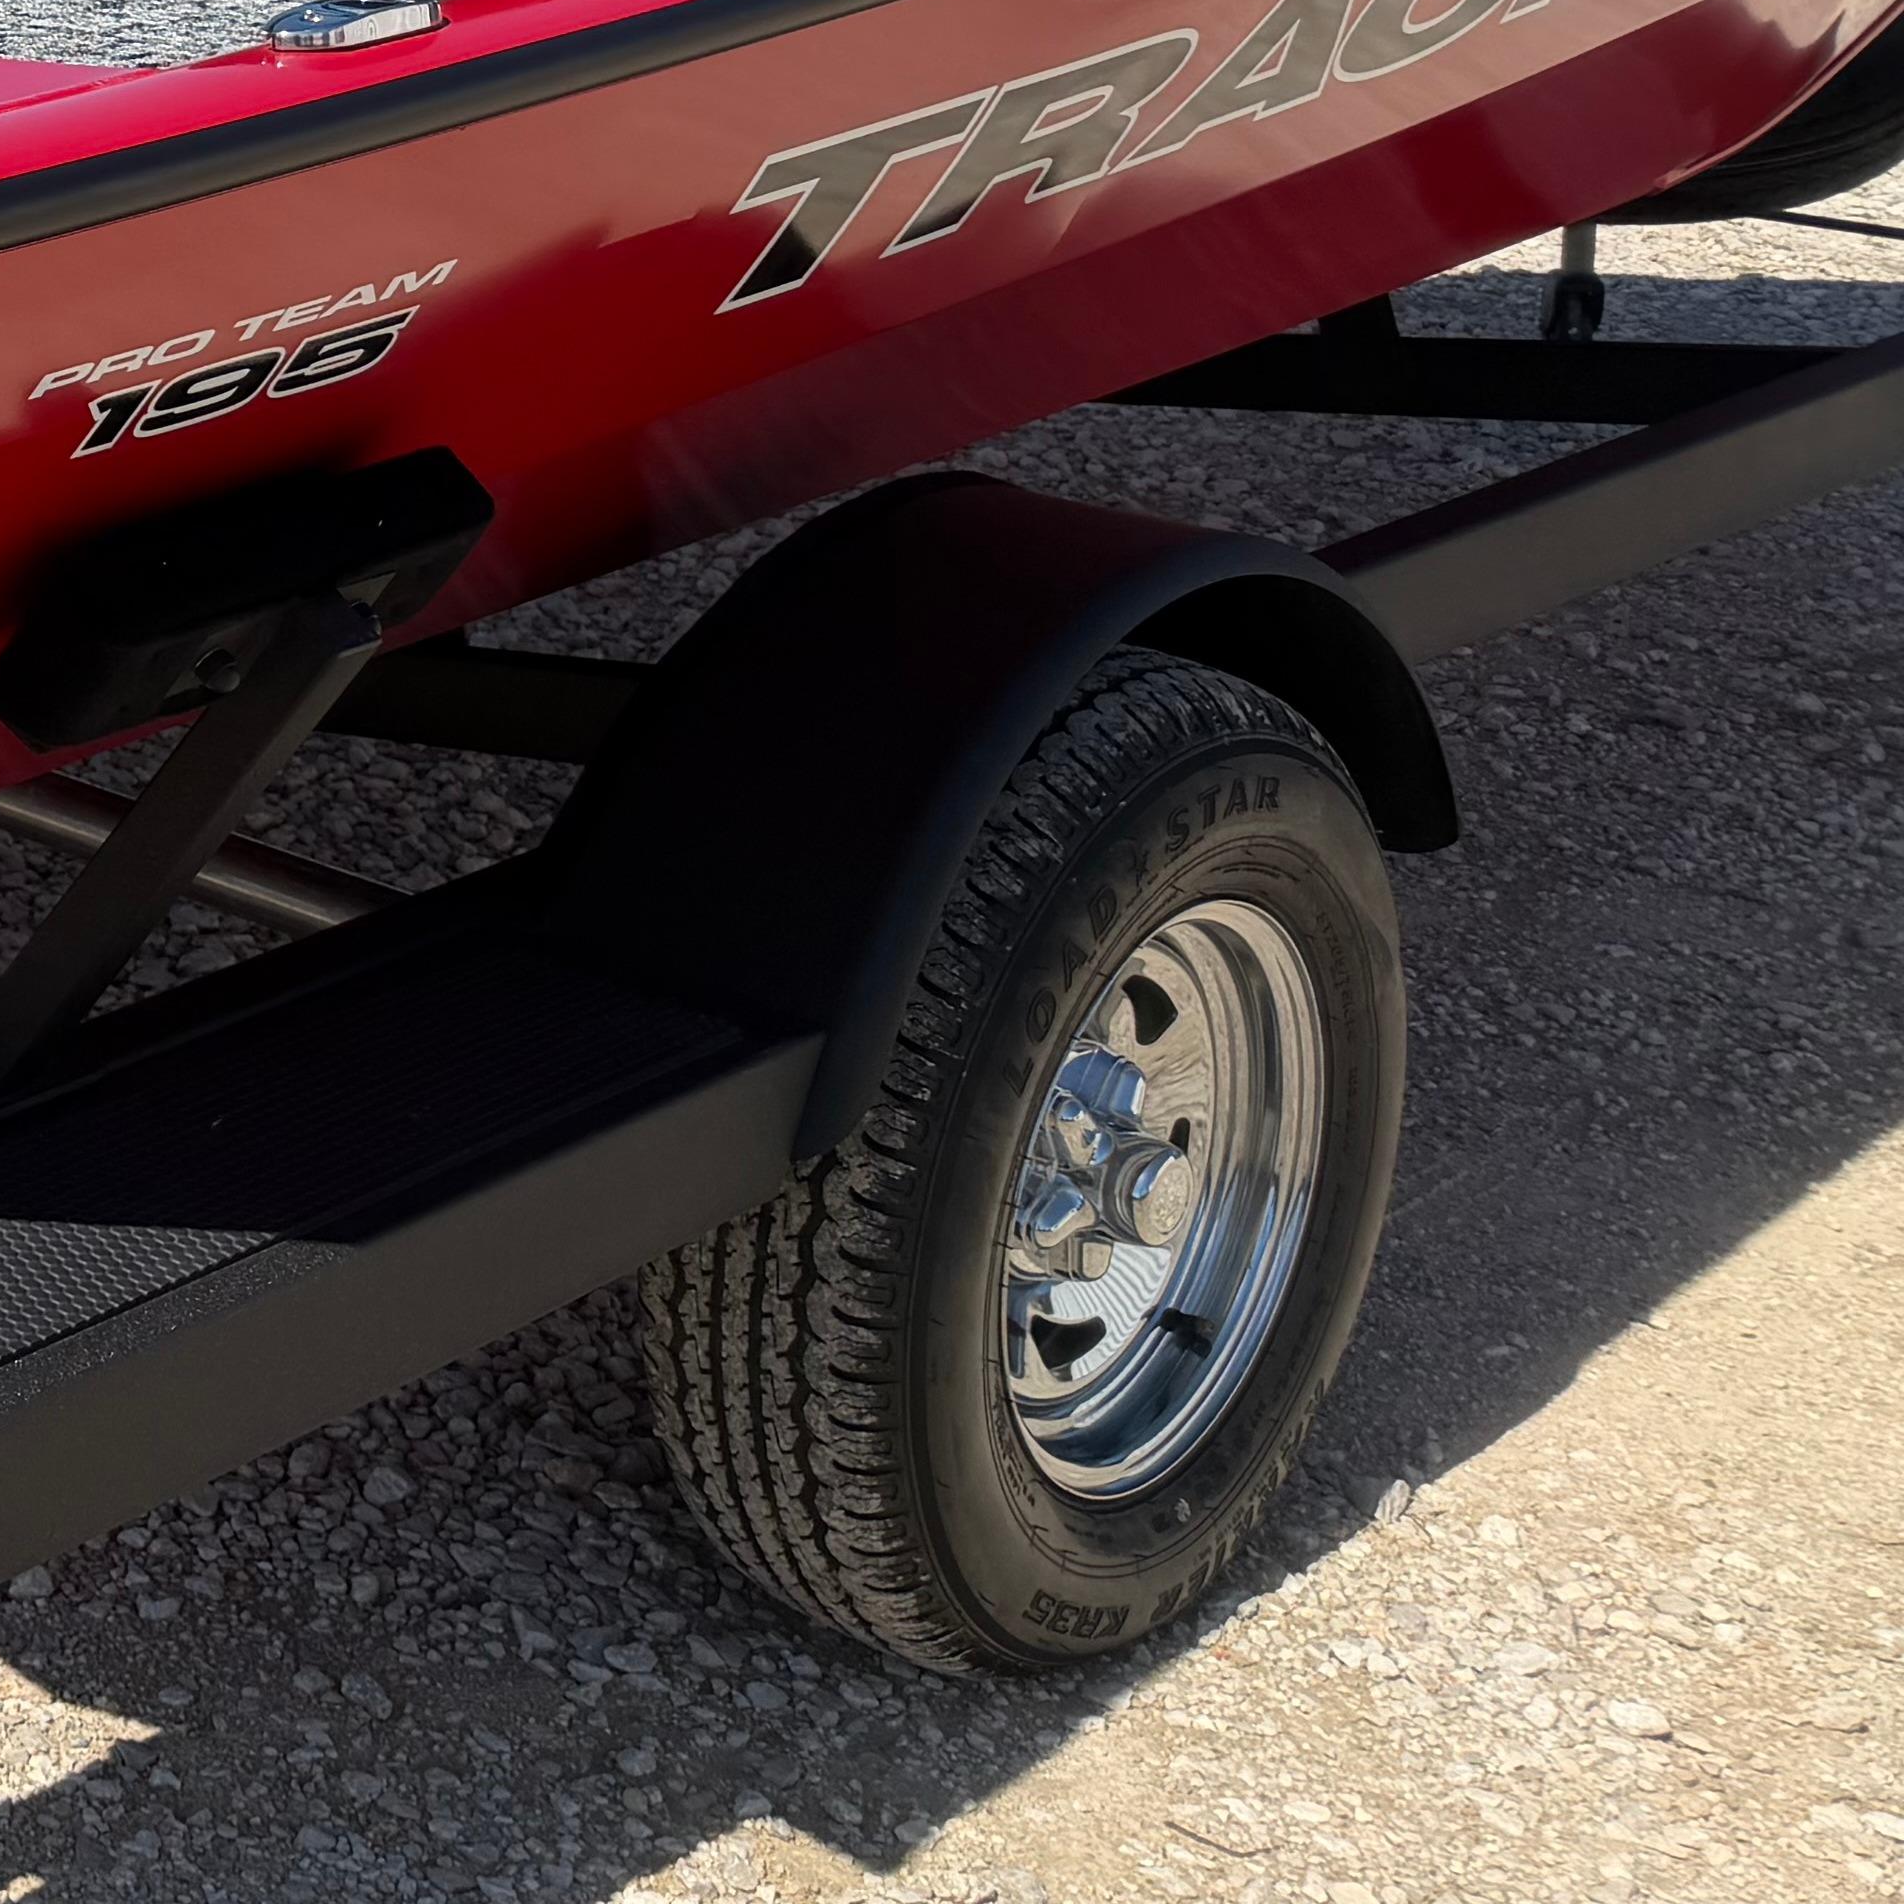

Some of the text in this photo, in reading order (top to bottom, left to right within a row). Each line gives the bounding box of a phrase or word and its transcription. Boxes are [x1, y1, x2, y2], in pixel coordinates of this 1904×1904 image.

[28, 259, 459, 400] PRO TEAM
[70, 304, 421, 459] 195
[1002, 776, 1280, 1098] LOAD STAR
